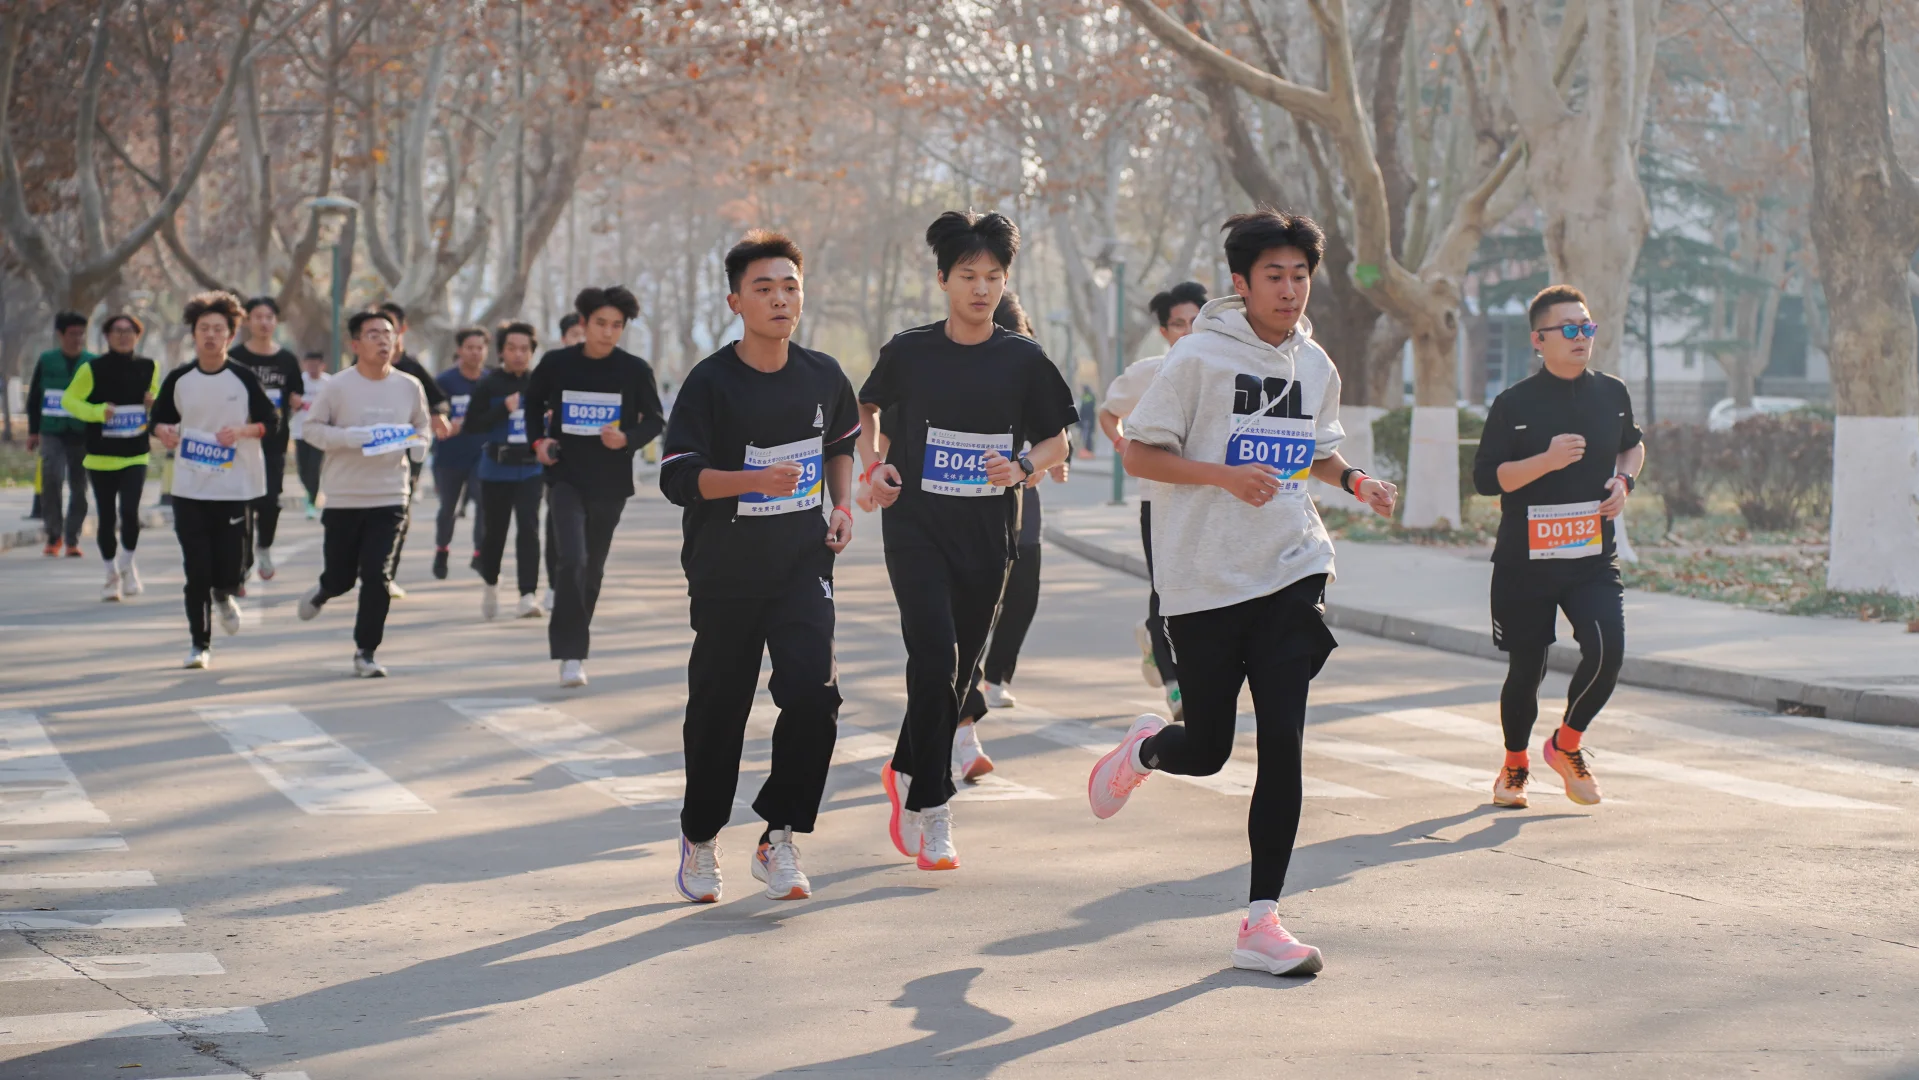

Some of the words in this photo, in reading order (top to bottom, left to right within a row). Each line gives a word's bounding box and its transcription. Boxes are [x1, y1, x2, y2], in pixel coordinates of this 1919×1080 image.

[569, 405, 615, 419] B0397
[187, 441, 229, 459] B0004
[1239, 440, 1307, 464] B0112
[934, 450, 987, 471] B045
[932, 485, 960, 493] 学生男子组
[1537, 519, 1595, 538] D0132
